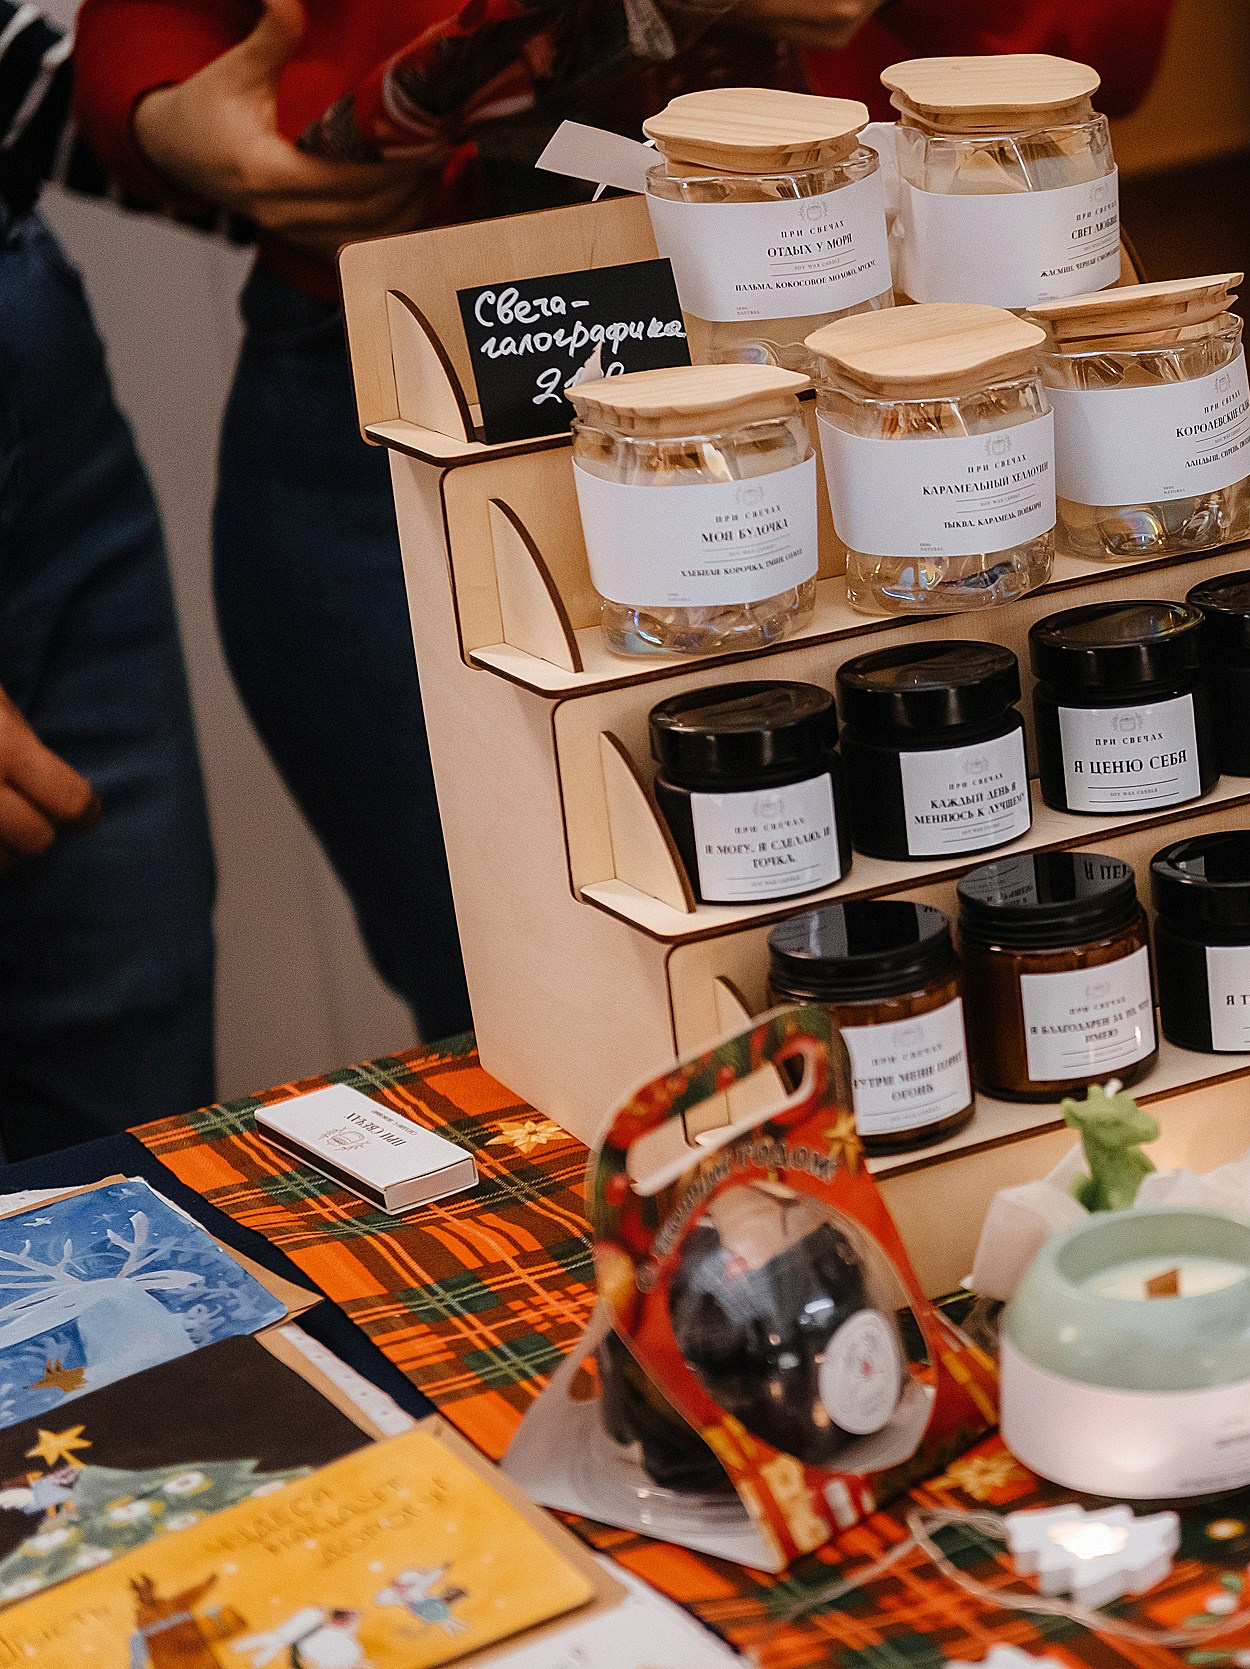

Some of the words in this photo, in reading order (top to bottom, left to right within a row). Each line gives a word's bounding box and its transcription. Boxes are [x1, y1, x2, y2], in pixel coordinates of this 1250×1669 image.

[781, 229, 803, 238] ПРИ
[810, 220, 844, 235] СВЕЧАХ
[1071, 226, 1092, 239] СВЕТ
[768, 244, 812, 257] ОТДЫХ
[816, 242, 823, 252] У
[827, 233, 852, 249] МОРЯ
[776, 277, 826, 289] КОКОСОВОЕ
[1204, 403, 1219, 414] ПРИ
[1176, 408, 1237, 437] КОРОЛЕВСКИЕ
[968, 465, 988, 473] ПРИ
[995, 454, 1026, 468] СВЕЧАХ
[923, 476, 1009, 495] КАРАМЕЛЬНЫЙ
[702, 531, 733, 542] МОЯ
[739, 518, 788, 540] БУЛОЧКА
[1122, 733, 1163, 744] СВЕЧАХ
[1074, 760, 1083, 773] Я
[1090, 759, 1143, 775] ЦЕНЮ
[1150, 750, 1187, 769] СЕБЯ
[949, 782, 967, 790] ПРИ
[972, 773, 1003, 786] СВЕЧАХ
[931, 793, 984, 809] КАЖДЫЙ
[987, 786, 1010, 800] ДЕНЬ
[1011, 782, 1016, 791] Я
[914, 811, 974, 824] МЕНЯЮСЬ
[977, 808, 985, 817] К
[735, 826, 756, 834] ПРИ
[705, 845, 713, 854] Я
[758, 842, 767, 852] Я
[824, 826, 831, 836] И
[1226, 995, 1234, 1005] Я
